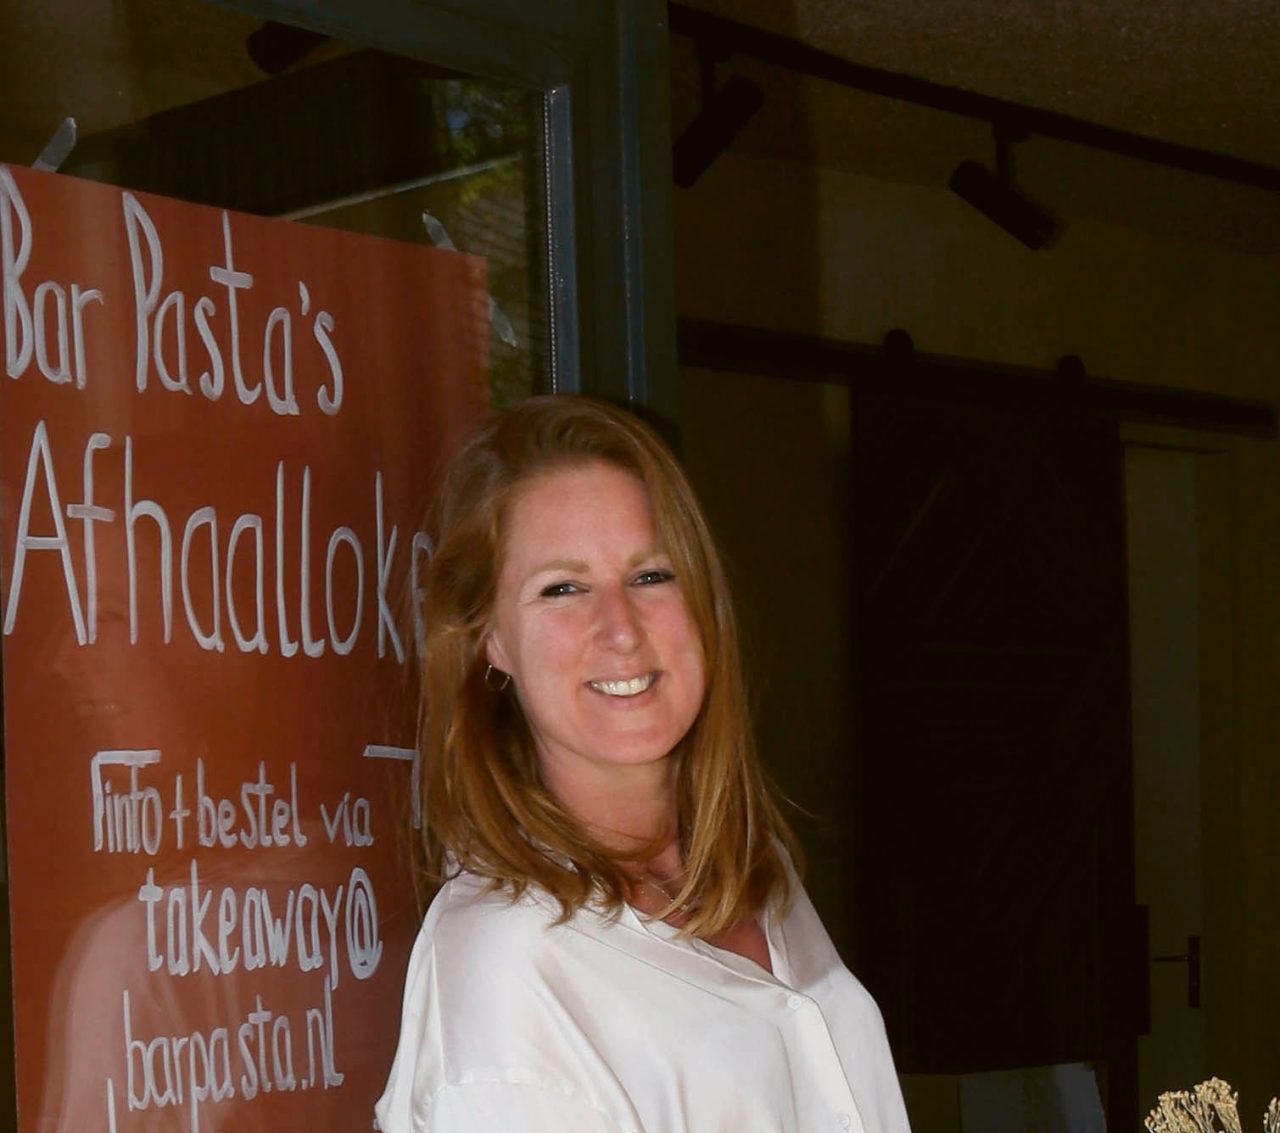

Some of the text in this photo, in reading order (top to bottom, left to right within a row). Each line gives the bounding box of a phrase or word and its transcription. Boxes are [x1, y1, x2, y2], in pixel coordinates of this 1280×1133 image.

[0, 163, 344, 415] Bar Pasta's
[105, 765, 162, 855] info
[197, 757, 308, 849] bestel
[320, 792, 375, 847] via
[139, 858, 383, 990] takeaway@
